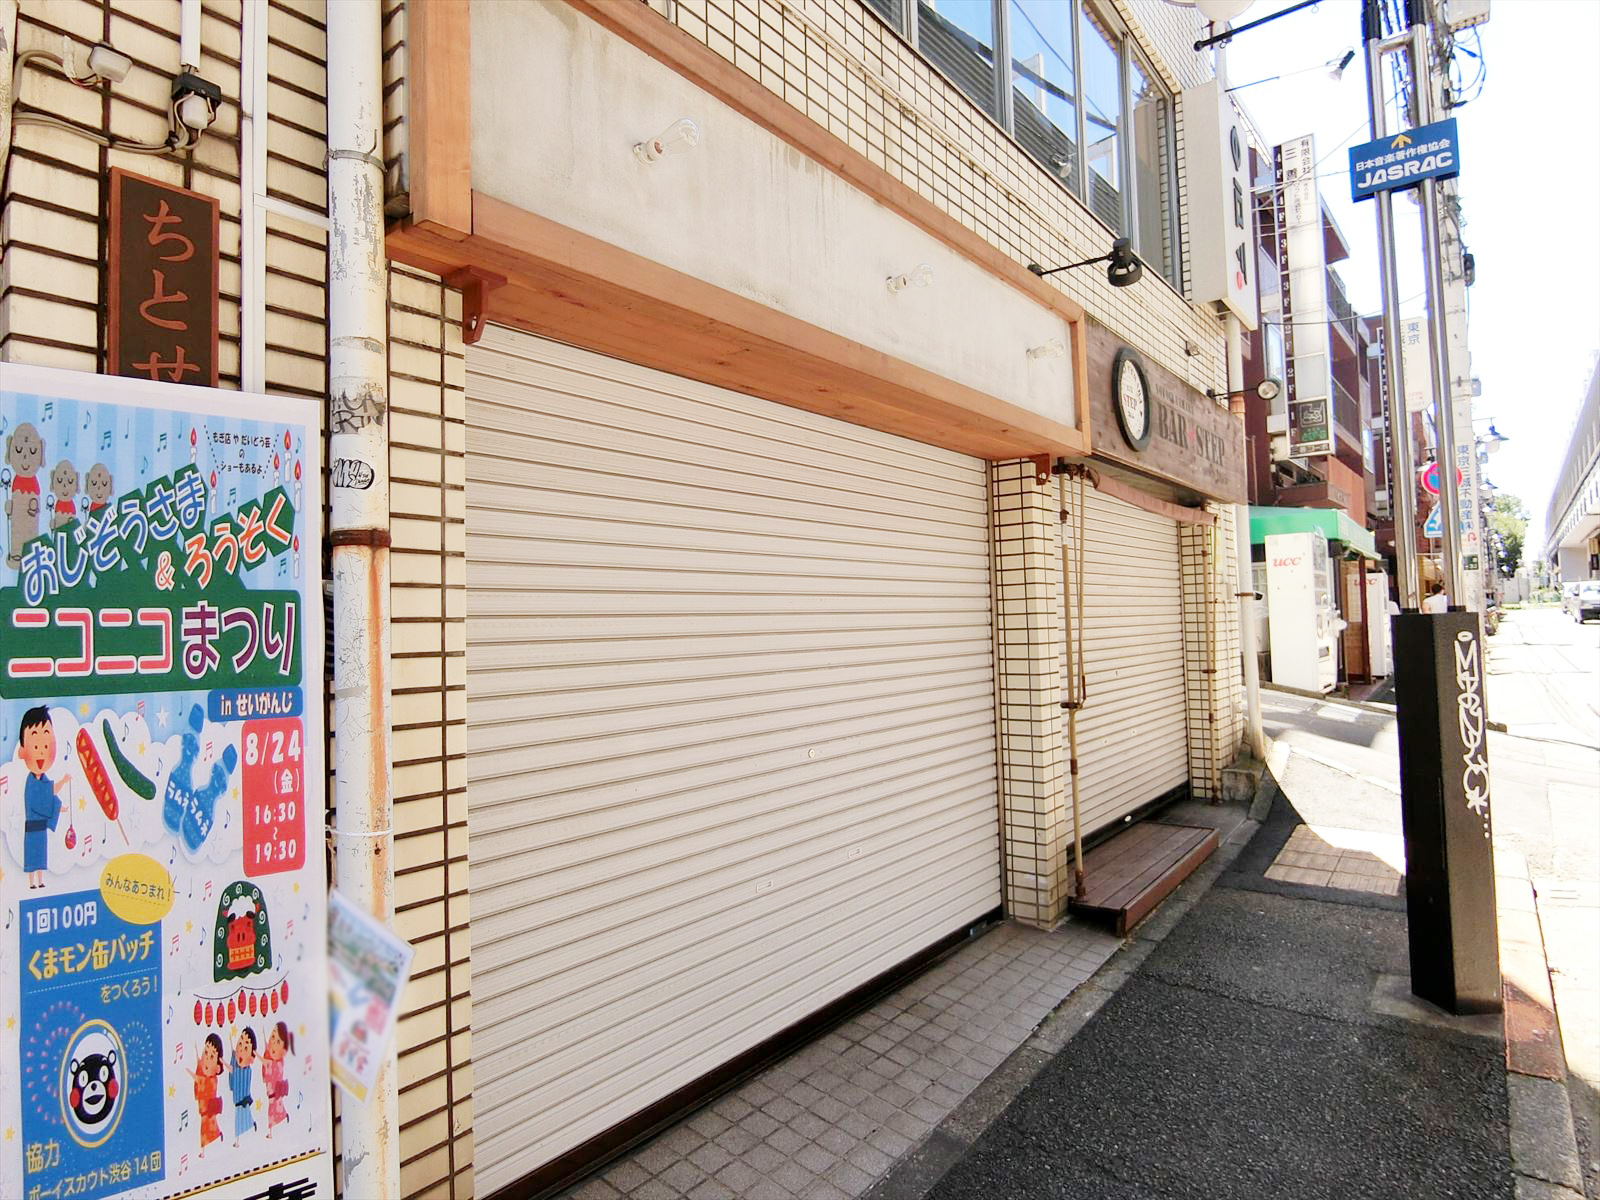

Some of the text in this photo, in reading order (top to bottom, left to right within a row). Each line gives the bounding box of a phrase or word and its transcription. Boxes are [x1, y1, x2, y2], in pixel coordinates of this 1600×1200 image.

[1356, 138, 1451, 172] 日本音楽著作権協会
[1357, 152, 1453, 189] JASRAC
[1158, 402, 1225, 467] BAR STEP
[21, 470, 207, 606] おじぞうさま
[155, 493, 293, 592] & ろうそく
[220, 691, 293, 717] in せいがんじ
[245, 729, 301, 767] 8/24
[255, 801, 296, 825] 16:30
[255, 839, 297, 864] 19:30
[27, 901, 97, 935] 1回100円
[28, 930, 155, 980] くまモン缶バッチ
[26, 1138, 61, 1174] 協力
